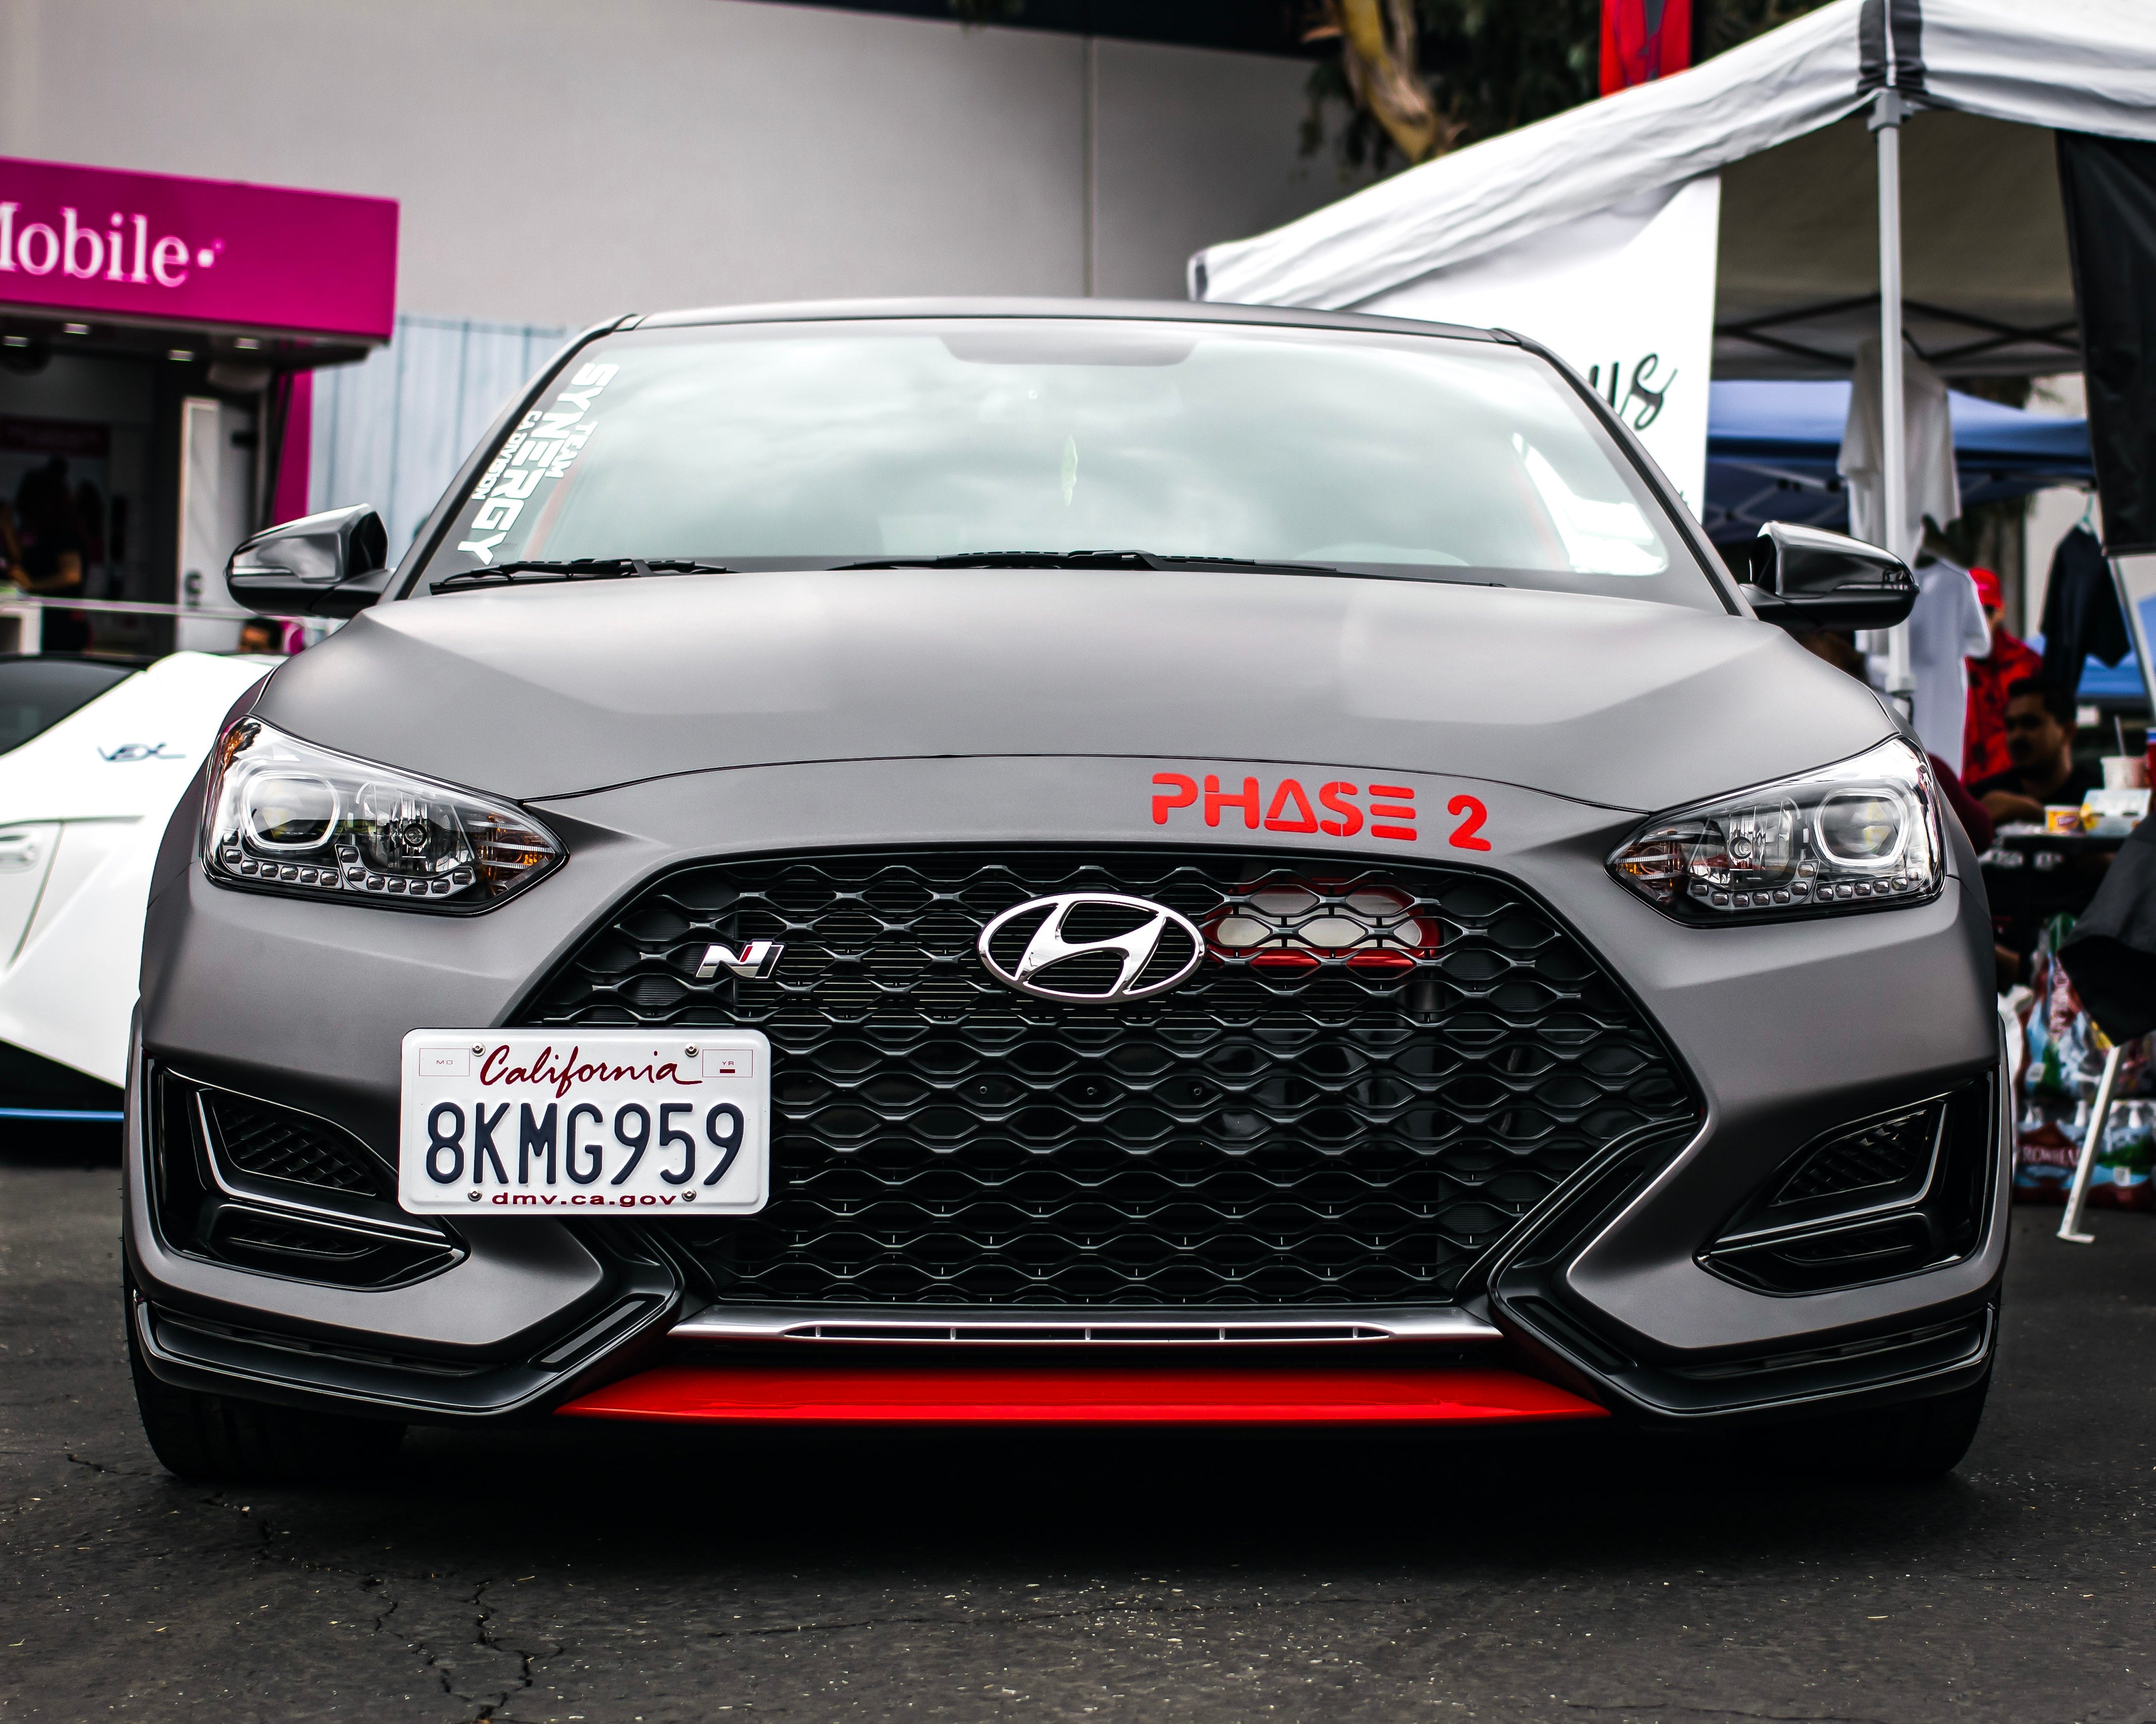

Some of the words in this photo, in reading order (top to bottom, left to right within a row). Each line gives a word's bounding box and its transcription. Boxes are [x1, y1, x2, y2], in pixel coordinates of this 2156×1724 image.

[518, 411, 543, 430] CA
[545, 421, 598, 478] TEAM
[457, 363, 620, 565] SYNERGY
[471, 432, 528, 500] DIVISION
[1152, 772, 1417, 841] PHASE
[1447, 795, 1491, 851] 2
[480, 1044, 703, 1098] California
[426, 1102, 744, 1185] 8KMG959
[492, 1192, 677, 1207] dmv.ca.gov
